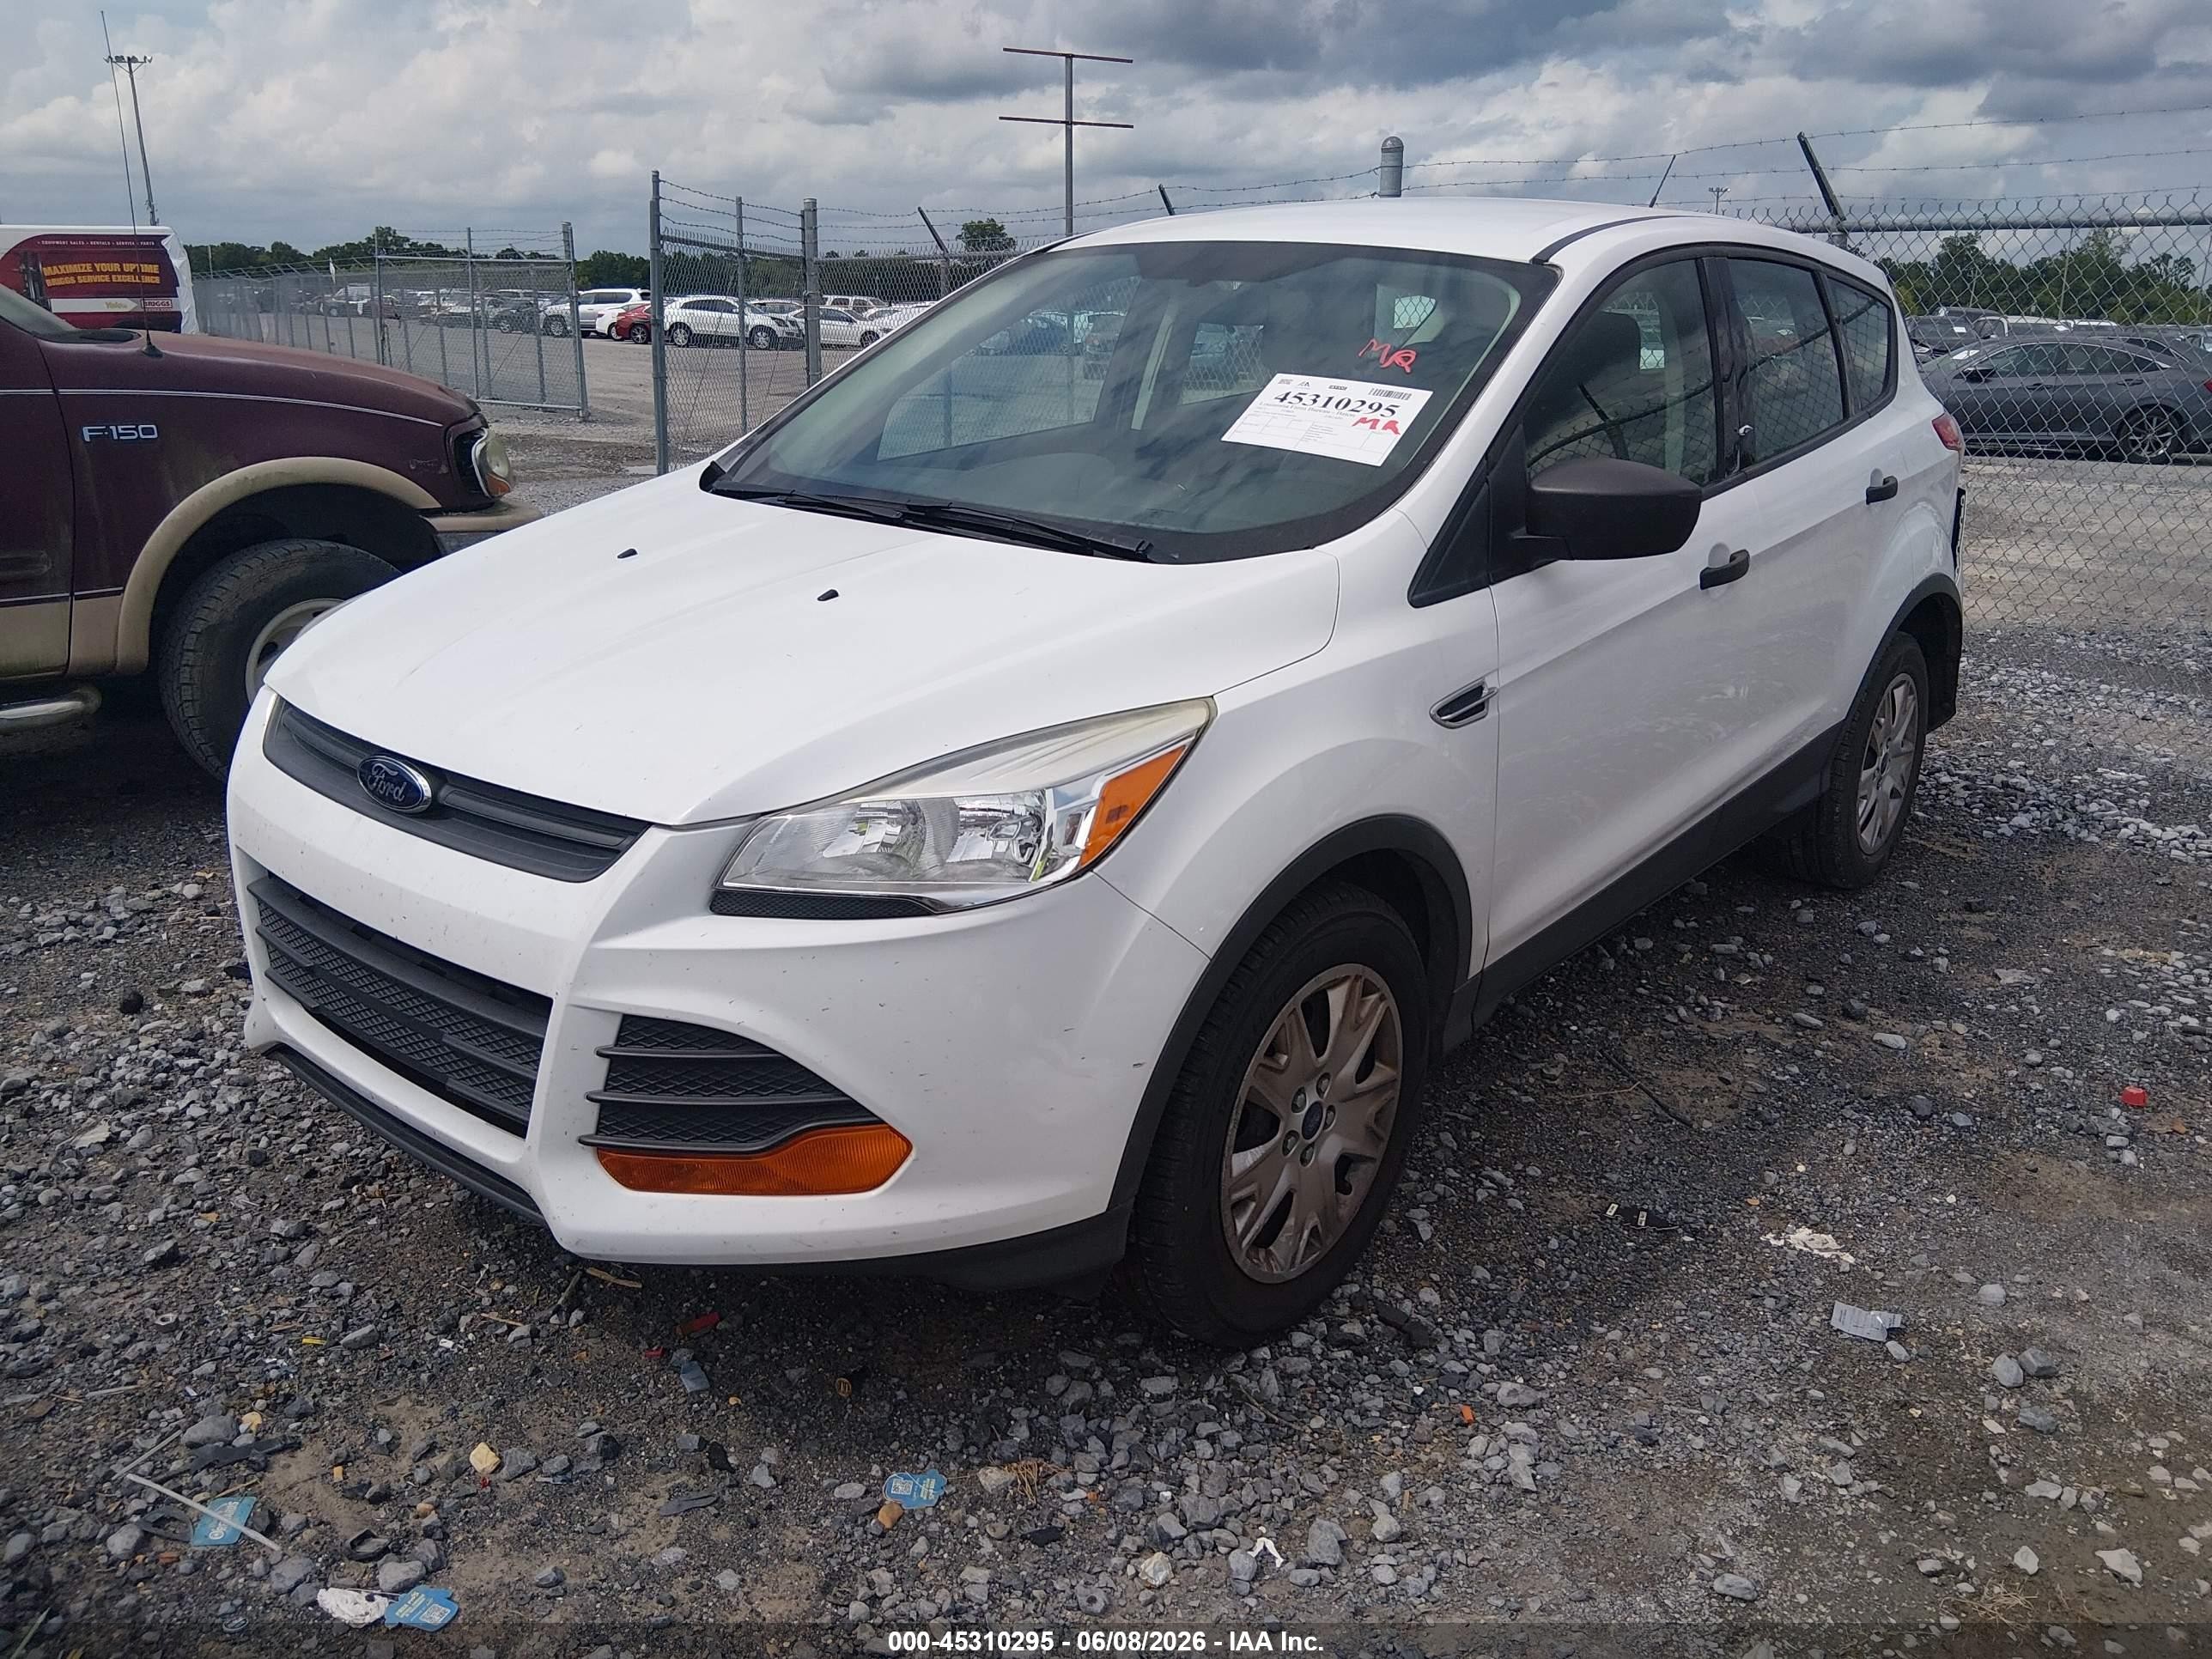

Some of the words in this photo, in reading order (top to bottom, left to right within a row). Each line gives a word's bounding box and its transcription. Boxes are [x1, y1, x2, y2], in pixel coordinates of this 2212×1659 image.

[43, 263, 94, 276] MAXIMIZE
[94, 263, 121, 272] YOUR
[77, 275, 111, 283] SERVICE
[112, 275, 161, 284] EXCELLENCE
[1274, 391, 1401, 418] 45310295
[367, 763, 406, 801] Ford
